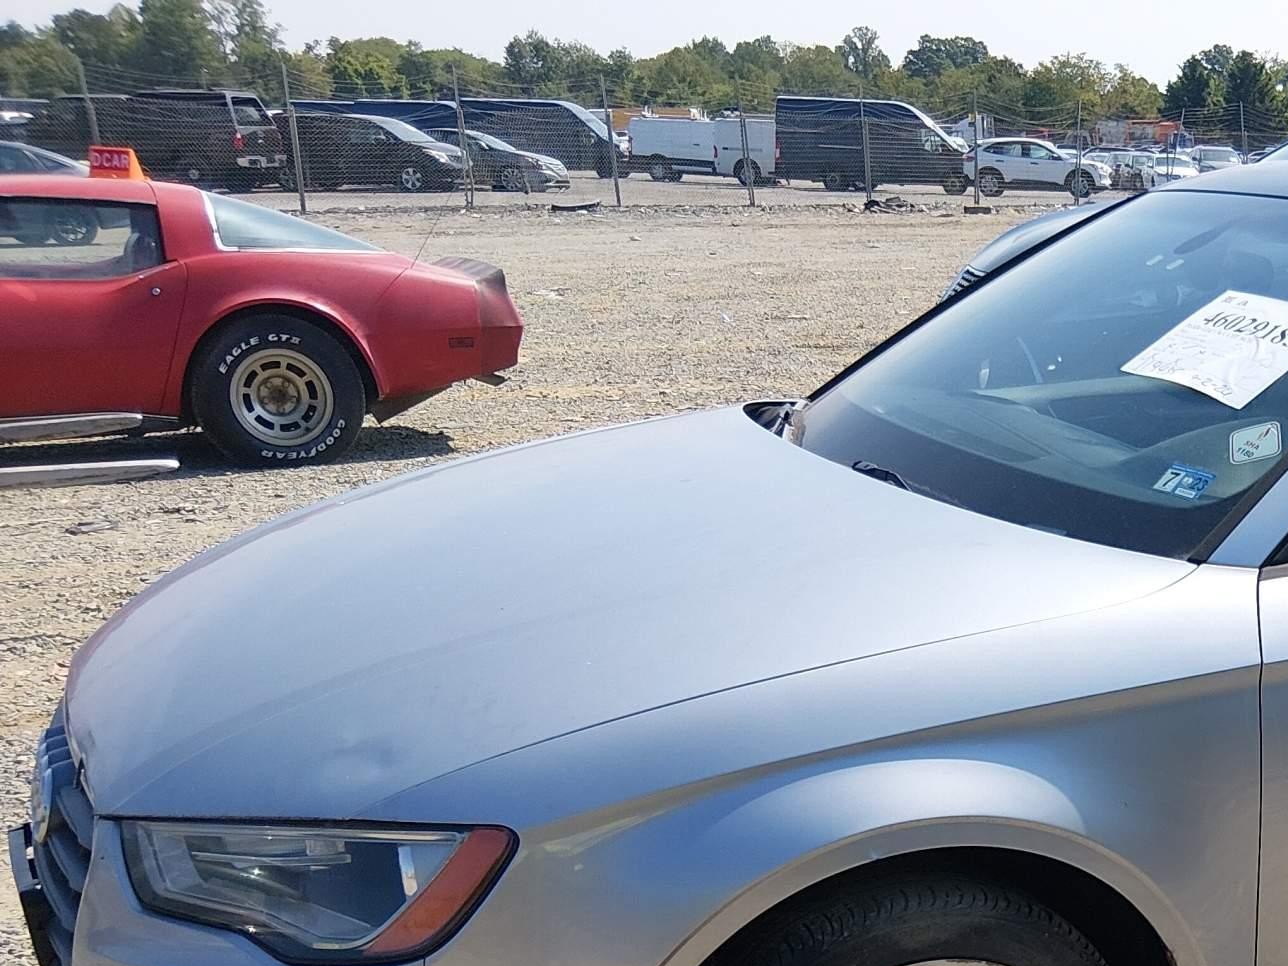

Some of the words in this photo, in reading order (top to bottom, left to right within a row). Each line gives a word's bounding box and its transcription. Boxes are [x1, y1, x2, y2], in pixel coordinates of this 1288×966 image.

[218, 336, 261, 374] EAGLE
[261, 418, 346, 460] GOODYEAR
[1162, 471, 1182, 488] 7
[1188, 477, 1210, 492] 23
